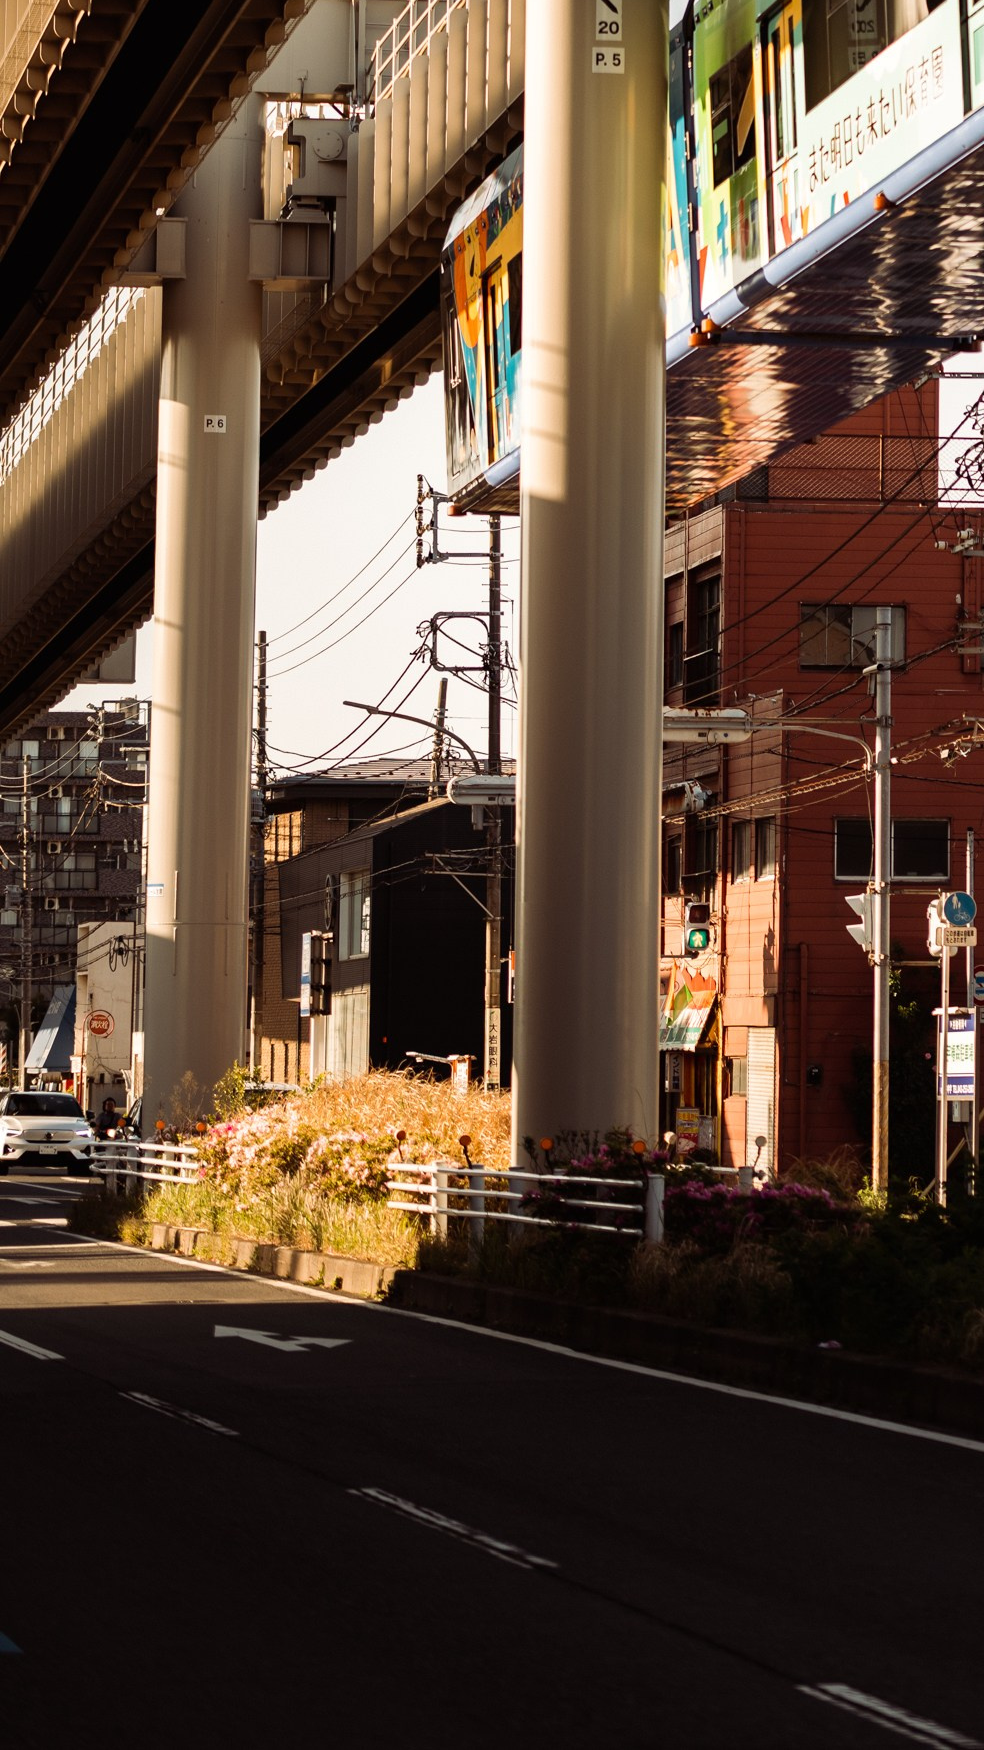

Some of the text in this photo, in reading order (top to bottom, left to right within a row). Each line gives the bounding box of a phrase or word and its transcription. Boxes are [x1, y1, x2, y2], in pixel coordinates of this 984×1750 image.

[598, 21, 619, 35] 20
[809, 45, 944, 193] また明日も来たい保育園
[488, 1023, 498, 1067] 大岩眼科
